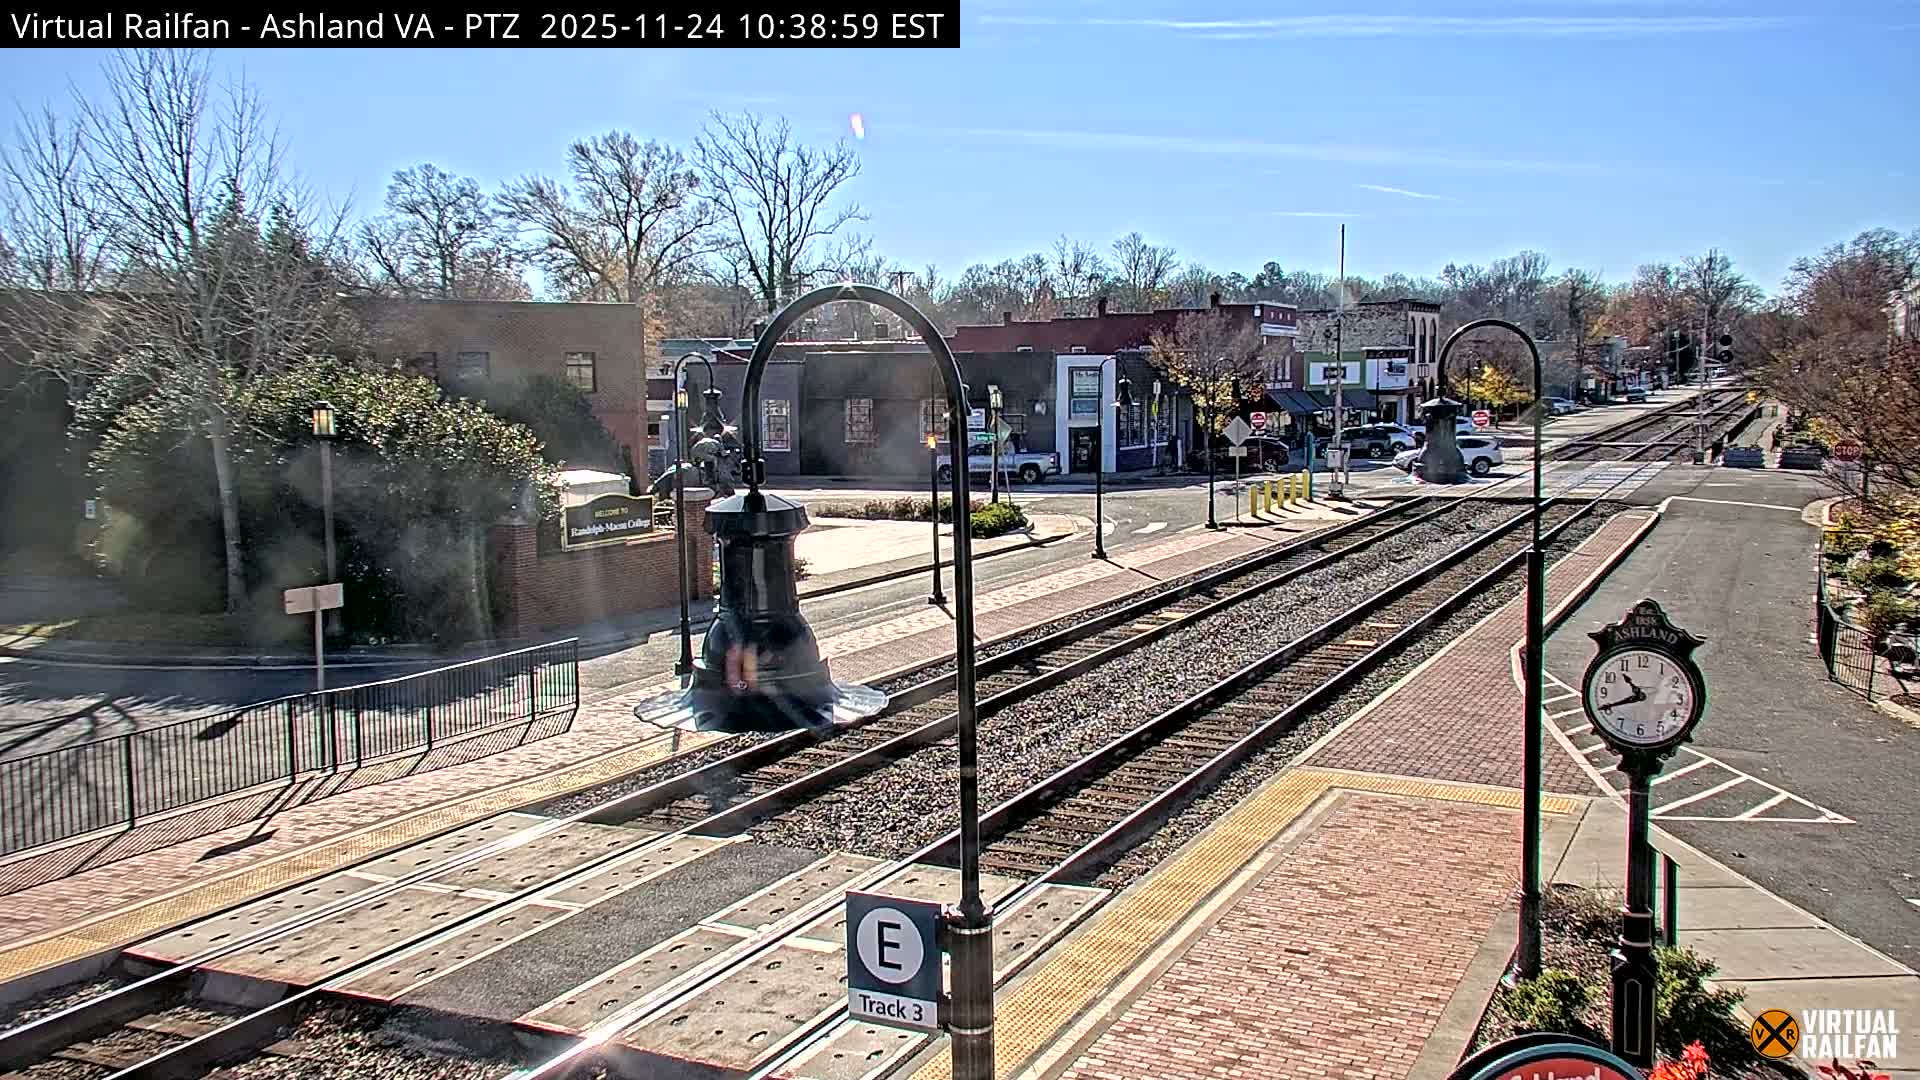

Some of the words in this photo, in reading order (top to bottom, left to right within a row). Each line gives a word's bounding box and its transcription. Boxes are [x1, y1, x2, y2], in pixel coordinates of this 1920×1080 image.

[1835, 445, 1860, 456] STOP
[570, 522, 627, 538] Randolph-Macon
[627, 518, 651, 529] College
[1615, 627, 1679, 645] ASHLAND
[1620, 659, 1629, 672] 11
[1637, 655, 1649, 669] 12
[1659, 662, 1664, 675] 1
[1604, 671, 1616, 684] 10
[1671, 676, 1679, 689] 2
[1600, 686, 1608, 699] 9
[1676, 693, 1684, 706] 3
[1670, 708, 1679, 721] 4
[1616, 717, 1625, 730] 7
[1636, 723, 1645, 736] 6
[1656, 720, 1665, 736] 5
[877, 919, 903, 971] E
[858, 993, 907, 1020] Track
[911, 1003, 924, 1022] 3
